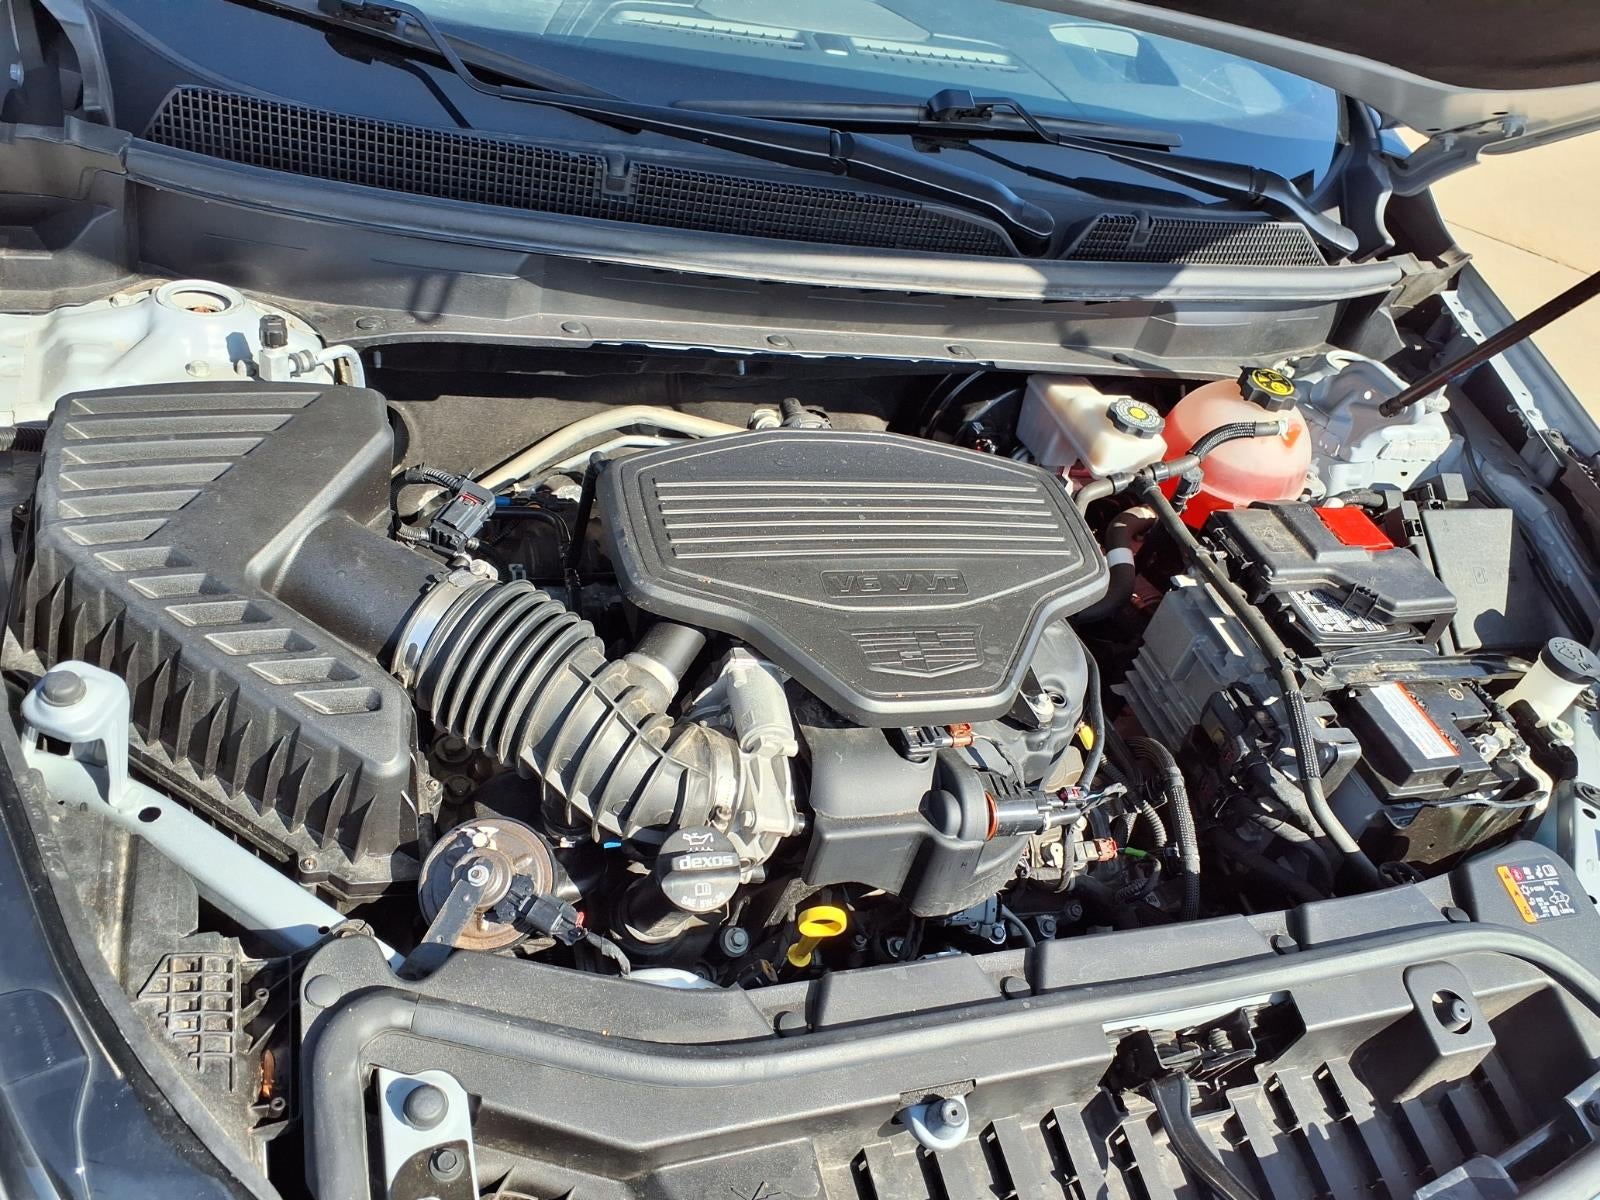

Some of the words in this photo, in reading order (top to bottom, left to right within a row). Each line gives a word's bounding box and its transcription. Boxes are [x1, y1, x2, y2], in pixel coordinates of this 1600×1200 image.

[828, 574, 882, 592] V6
[886, 573, 959, 591] VVT
[679, 855, 733, 870] dexos
[680, 895, 697, 908] SAE
